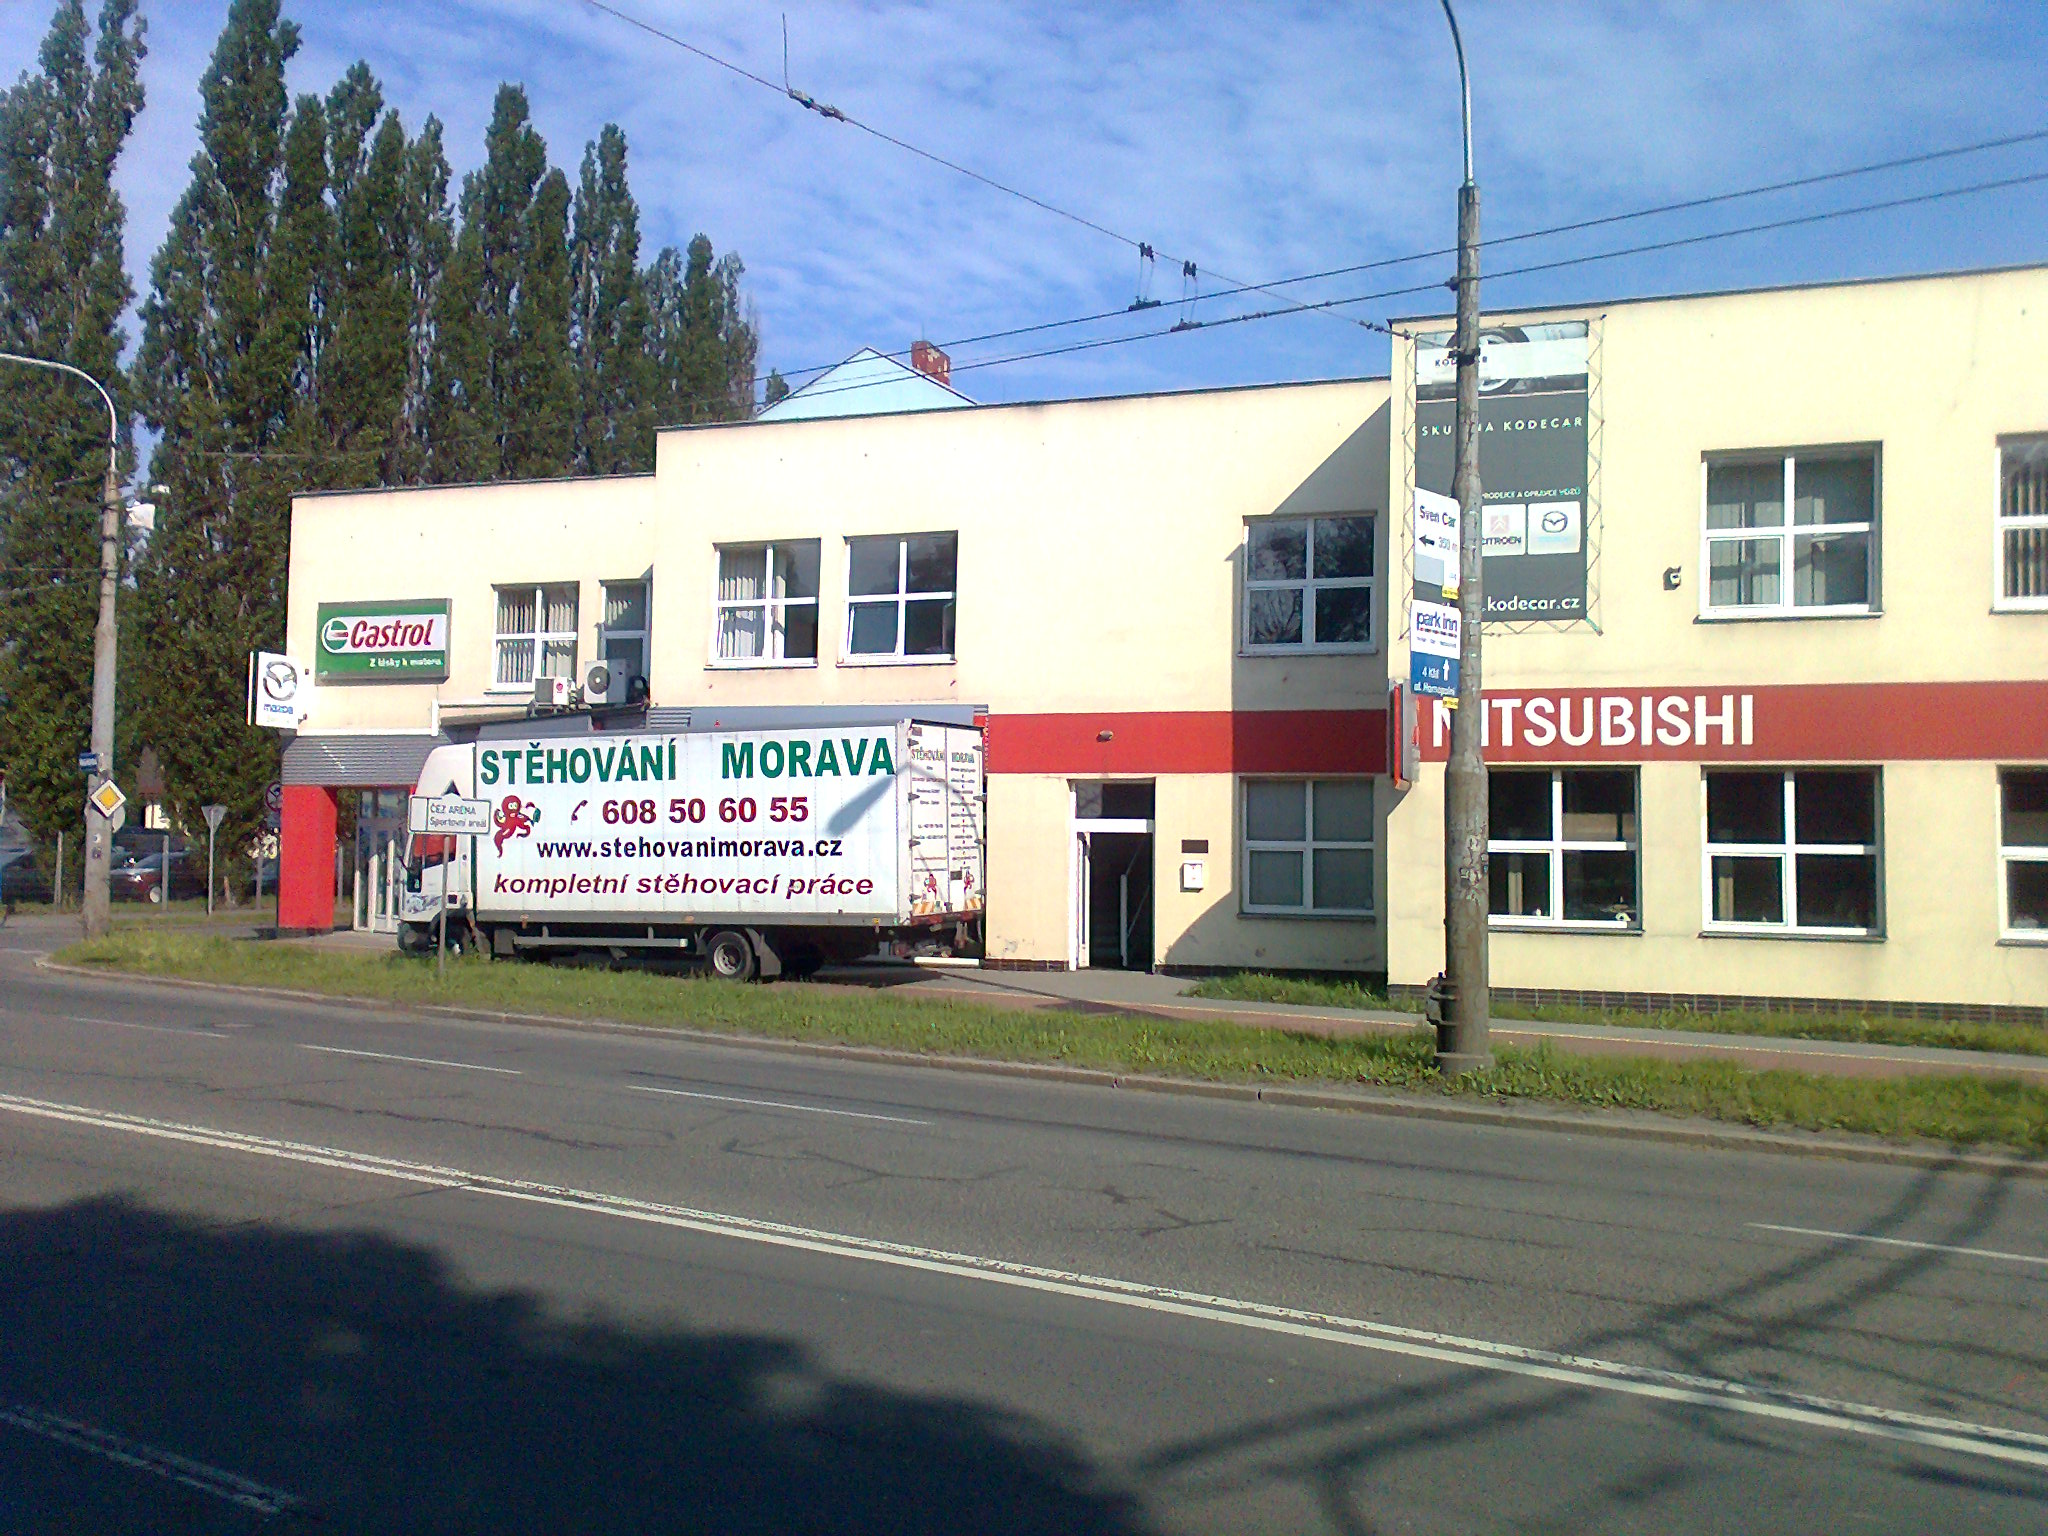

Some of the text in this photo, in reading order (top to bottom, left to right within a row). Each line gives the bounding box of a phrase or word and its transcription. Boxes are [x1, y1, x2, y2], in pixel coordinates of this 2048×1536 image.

[1421, 416, 1583, 436] SKUA KODECAR
[1419, 505, 1457, 528] Sven Car
[1482, 595, 1580, 613] .kodecar.cz
[1416, 611, 1458, 632] park inn
[350, 618, 434, 649] Castrol
[1422, 666, 1428, 678] 4
[480, 737, 894, 785] STĚHOVÁNÍ MORAVA
[602, 796, 808, 825] 608 50 60 55
[537, 836, 843, 858] www.stehovanimorava.cz
[494, 873, 874, 899] kompletní stěhovací práce
